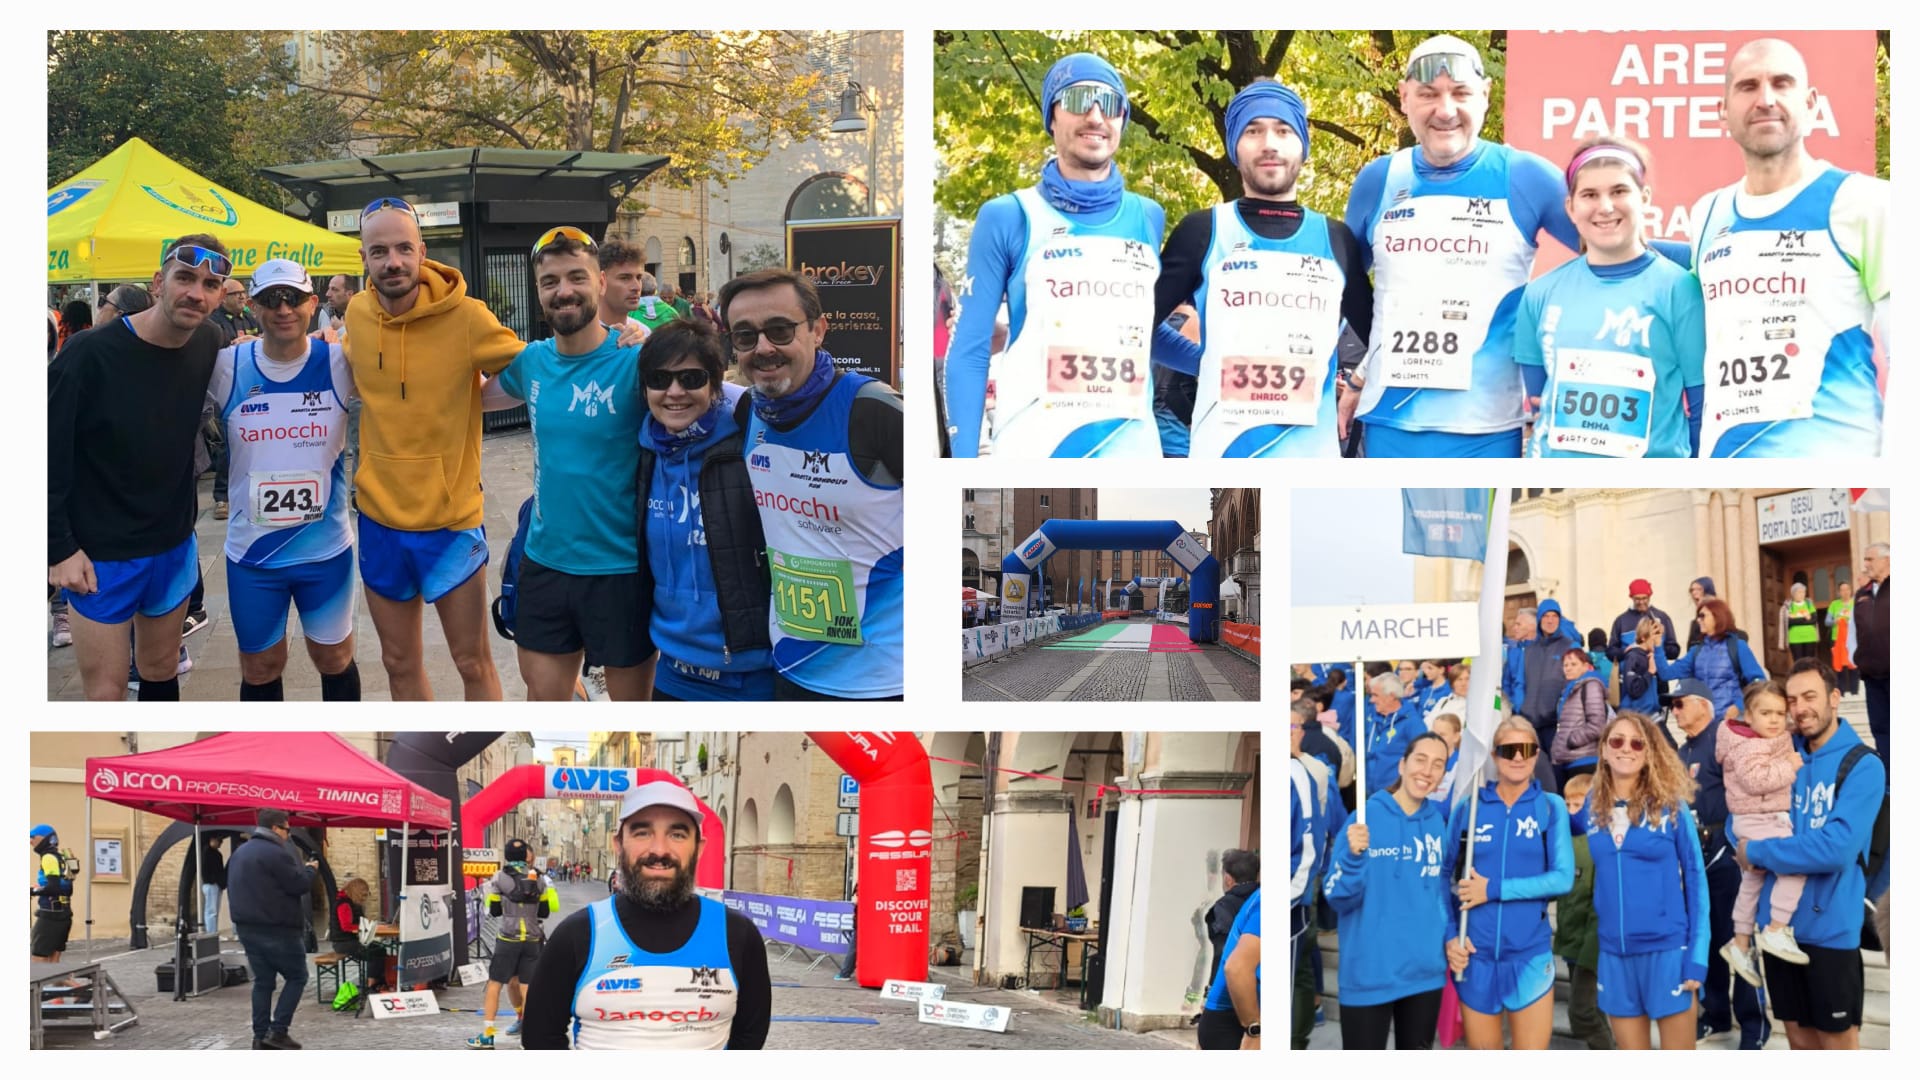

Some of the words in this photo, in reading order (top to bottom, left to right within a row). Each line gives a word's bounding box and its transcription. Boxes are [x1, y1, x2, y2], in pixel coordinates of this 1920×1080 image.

[1611, 44, 1727, 86] ARE
[1384, 208, 1415, 220] AVIS
[1043, 248, 1083, 260] AVIS
[1704, 246, 1732, 264] AVIS
[801, 261, 884, 285] brokey
[1222, 261, 1258, 272] AVIS
[1392, 331, 1458, 354] 2288
[1060, 355, 1136, 383] 3338
[1719, 354, 1791, 387] 2032
[1232, 364, 1306, 391] 3339
[1250, 393, 1288, 401] ENRICO
[1738, 389, 1762, 398] IVAN
[241, 403, 269, 413] AVIS
[1563, 390, 1640, 423] 5003
[1581, 420, 1610, 432] EMMA
[293, 440, 327, 449] software
[1591, 438, 1606, 446] ON
[751, 454, 771, 469] AVIS
[264, 488, 312, 512] 243
[1762, 520, 1790, 540] PORTA
[1791, 518, 1801, 535] DI
[1802, 511, 1846, 533] SALVEZZA
[777, 580, 832, 622] 1151
[826, 626, 858, 639] ANCONA
[1341, 618, 1449, 640] MARCHE
[552, 767, 630, 792] AVIS
[846, 780, 856, 792] P
[186, 781, 304, 803] PROFESSIONAL
[317, 787, 379, 805] TIMING
[890, 911, 922, 922] YOUR
[596, 978, 641, 990] AVIS
